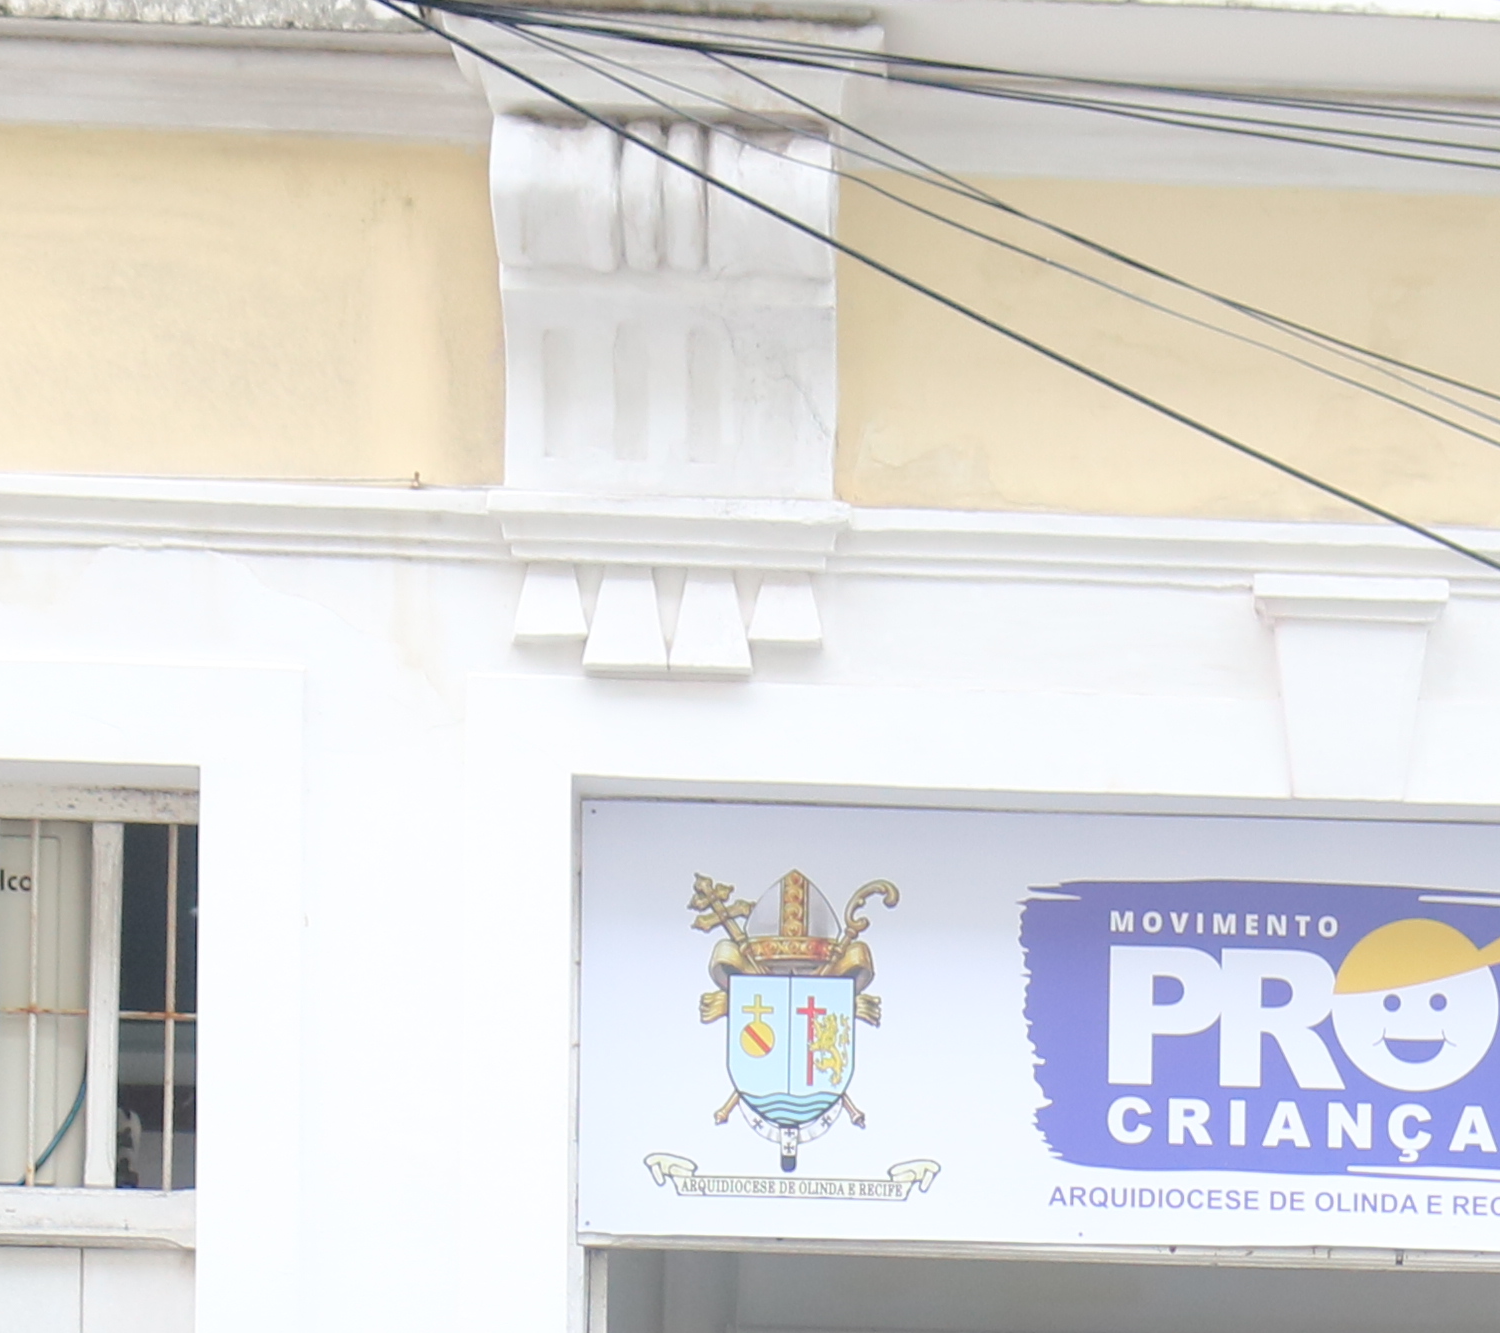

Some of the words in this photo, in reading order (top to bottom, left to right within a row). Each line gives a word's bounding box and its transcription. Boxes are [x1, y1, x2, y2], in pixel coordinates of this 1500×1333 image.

[1109, 909, 1339, 938] MOVIMENTO
[1107, 1096, 1497, 1163] CRIANÇA
[681, 1178, 776, 1195] ARQUIDIOCESE
[779, 1182, 796, 1195] DE
[799, 1181, 845, 1196] OLINDA
[848, 1184, 855, 1196] E
[859, 1184, 903, 1197] RECIFE
[1049, 1186, 1260, 1212] ARQUIDIOCESE
[1269, 1191, 1305, 1211] DE
[1315, 1192, 1418, 1214] OLINDA
[1427, 1195, 1442, 1214] E
